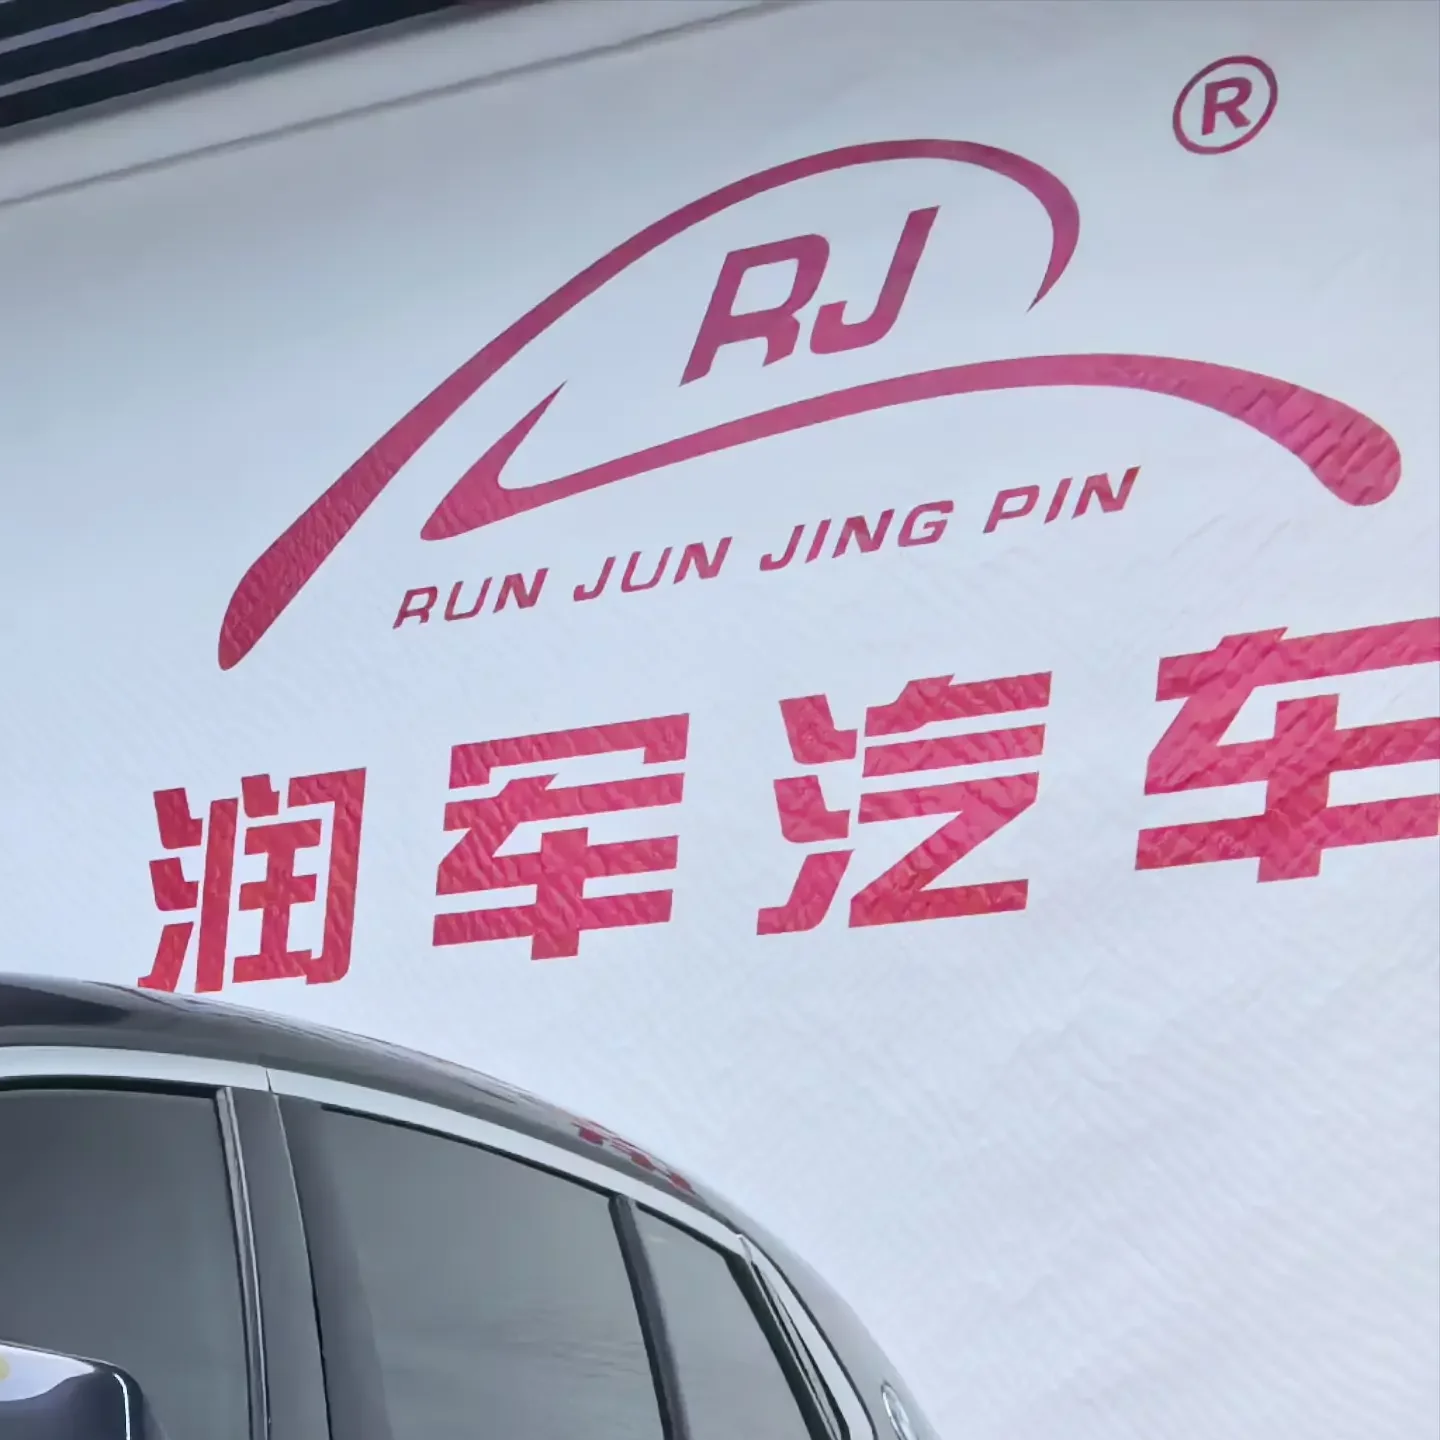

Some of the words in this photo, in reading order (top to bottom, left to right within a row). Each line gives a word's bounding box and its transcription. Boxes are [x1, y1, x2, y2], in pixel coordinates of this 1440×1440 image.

[679, 205, 940, 386] RJ
[392, 567, 548, 630] RUN
[573, 536, 732, 602] JUN
[759, 500, 955, 573] JING
[982, 465, 1142, 535] PIN
[137, 616, 1440, 995] 润军汽车
